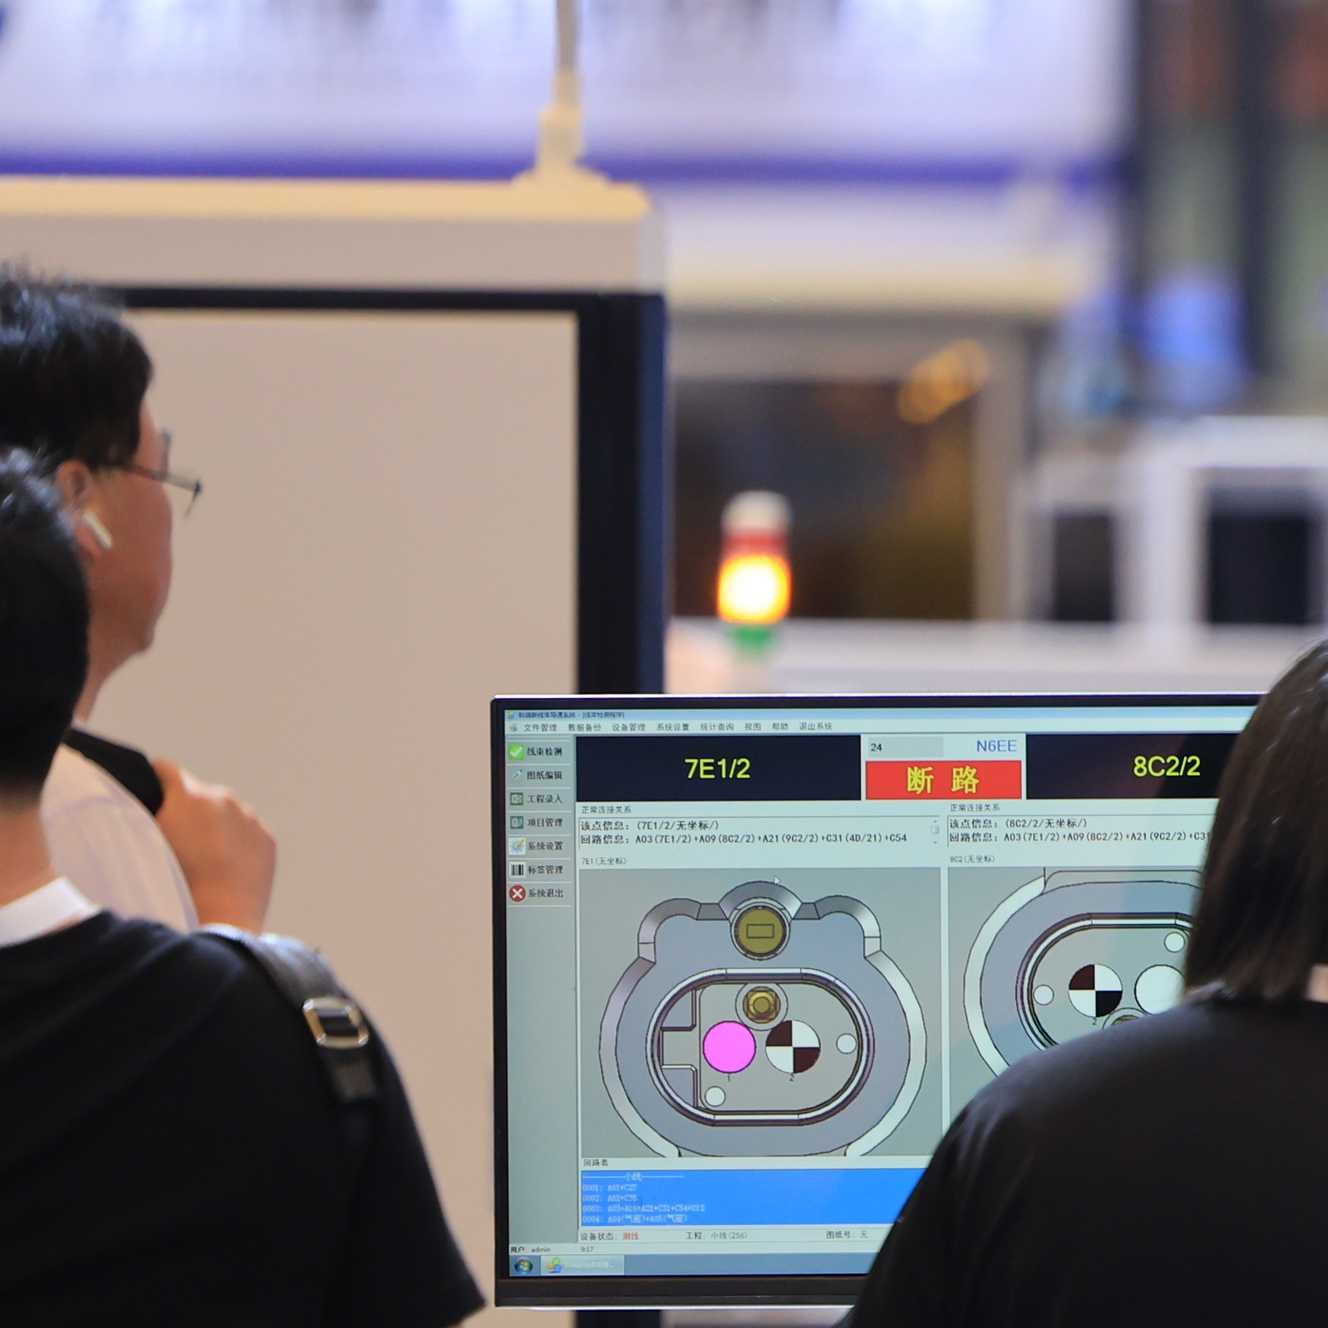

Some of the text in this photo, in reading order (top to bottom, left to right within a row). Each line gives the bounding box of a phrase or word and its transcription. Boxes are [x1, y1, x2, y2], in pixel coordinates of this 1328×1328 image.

[870, 743, 882, 752] 24
[976, 739, 1017, 752] N6EE
[684, 758, 751, 779] 7E1/2
[1133, 755, 1201, 777] 8C2/2
